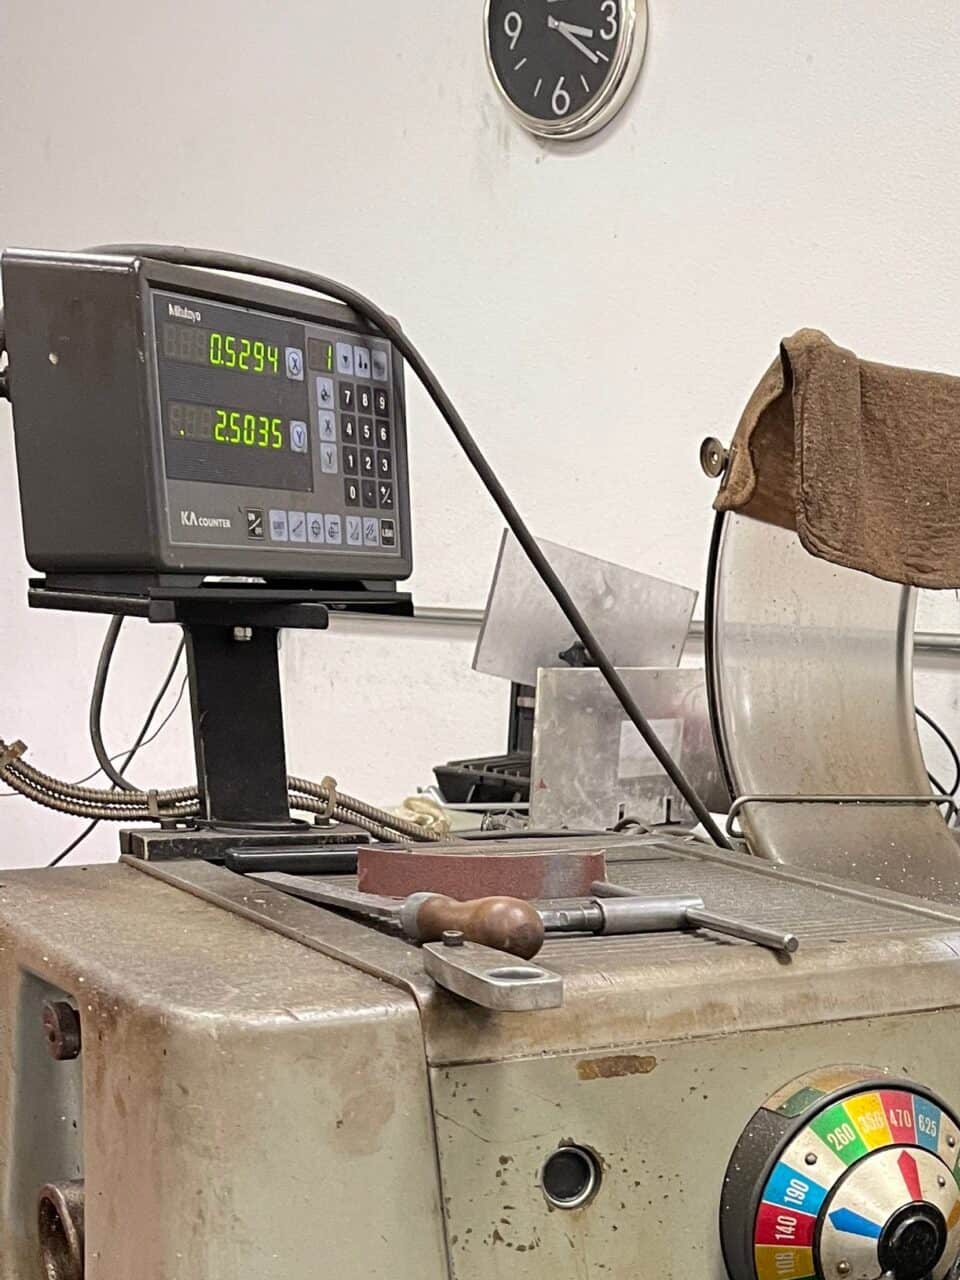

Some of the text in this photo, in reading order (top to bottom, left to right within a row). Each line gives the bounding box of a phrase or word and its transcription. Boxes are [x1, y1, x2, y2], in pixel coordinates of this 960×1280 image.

[600, 0, 617, 40] 3
[504, 11, 522, 50] 9
[551, 76, 570, 116] 6
[210, 333, 278, 373] 0.5294
[344, 390, 351, 404] 7
[362, 393, 368, 407] 8
[380, 396, 385, 410] 9
[214, 410, 283, 449] 2.5035
[324, 419, 332, 433] X
[346, 422, 353, 436] 4
[363, 425, 370, 438] 5
[381, 427, 387, 441] 6
[326, 451, 333, 465] Y
[348, 455, 354, 468] 1
[365, 456, 372, 470] 2
[382, 459, 388, 471] 3
[349, 486, 356, 499] 0
[198, 517, 232, 528] COUNTER
[889, 1108, 912, 1128] 470
[918, 1113, 937, 1137] 625
[826, 1123, 856, 1151] 260
[783, 1178, 810, 1205] 190
[774, 1215, 798, 1241] 140
[775, 1251, 795, 1275] 108
